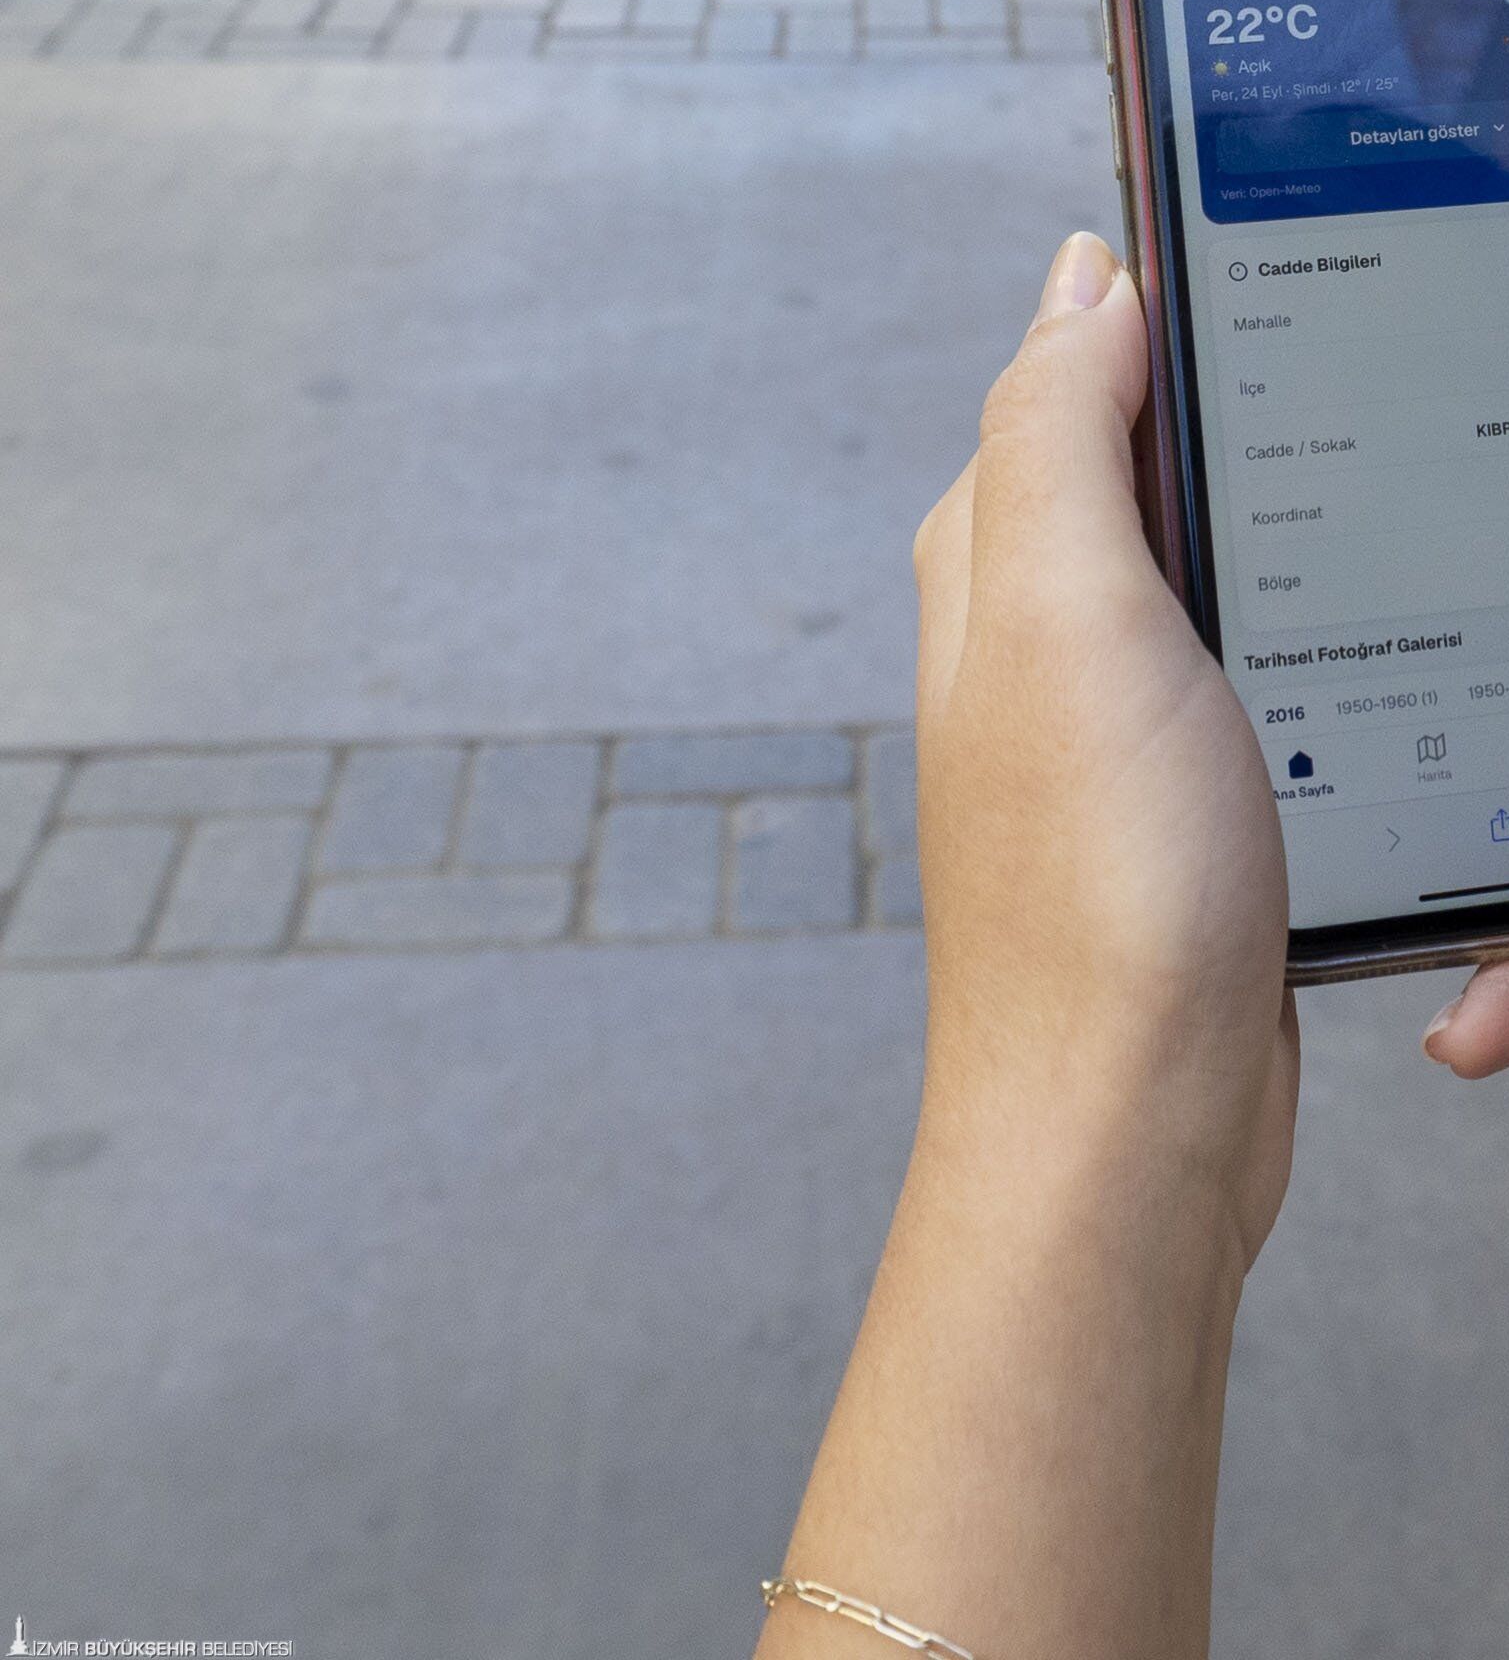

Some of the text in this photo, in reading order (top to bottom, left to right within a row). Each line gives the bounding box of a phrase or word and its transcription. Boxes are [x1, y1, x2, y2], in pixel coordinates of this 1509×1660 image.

[1207, 4, 1319, 46] 22°C
[1238, 59, 1272, 77] Açık
[1211, 89, 1239, 102] Per,
[1241, 87, 1258, 100] 24
[1262, 85, 1283, 100] Eyl
[1293, 82, 1331, 99] Şimdi
[1350, 123, 1480, 147] Detayları göster
[1220, 183, 1321, 201] Veri: Open-Meteo
[1257, 253, 1382, 277] Cadde Bilgileri
[1233, 313, 1292, 332] Mahalle
[1239, 379, 1266, 399] İlçe
[1245, 442, 1294, 461] Cadde
[1310, 437, 1357, 457] Sokak
[1251, 505, 1323, 526] Koordinat
[1257, 572, 1302, 593] Bölge
[1244, 632, 1463, 671] Tarihsel Fotoğraf Galerisi
[1336, 690, 1439, 716] 1950-1960 (1)
[1265, 706, 1306, 724] 2016
[1417, 769, 1453, 784] Harita
[1273, 783, 1335, 802] Ana Sayfa
